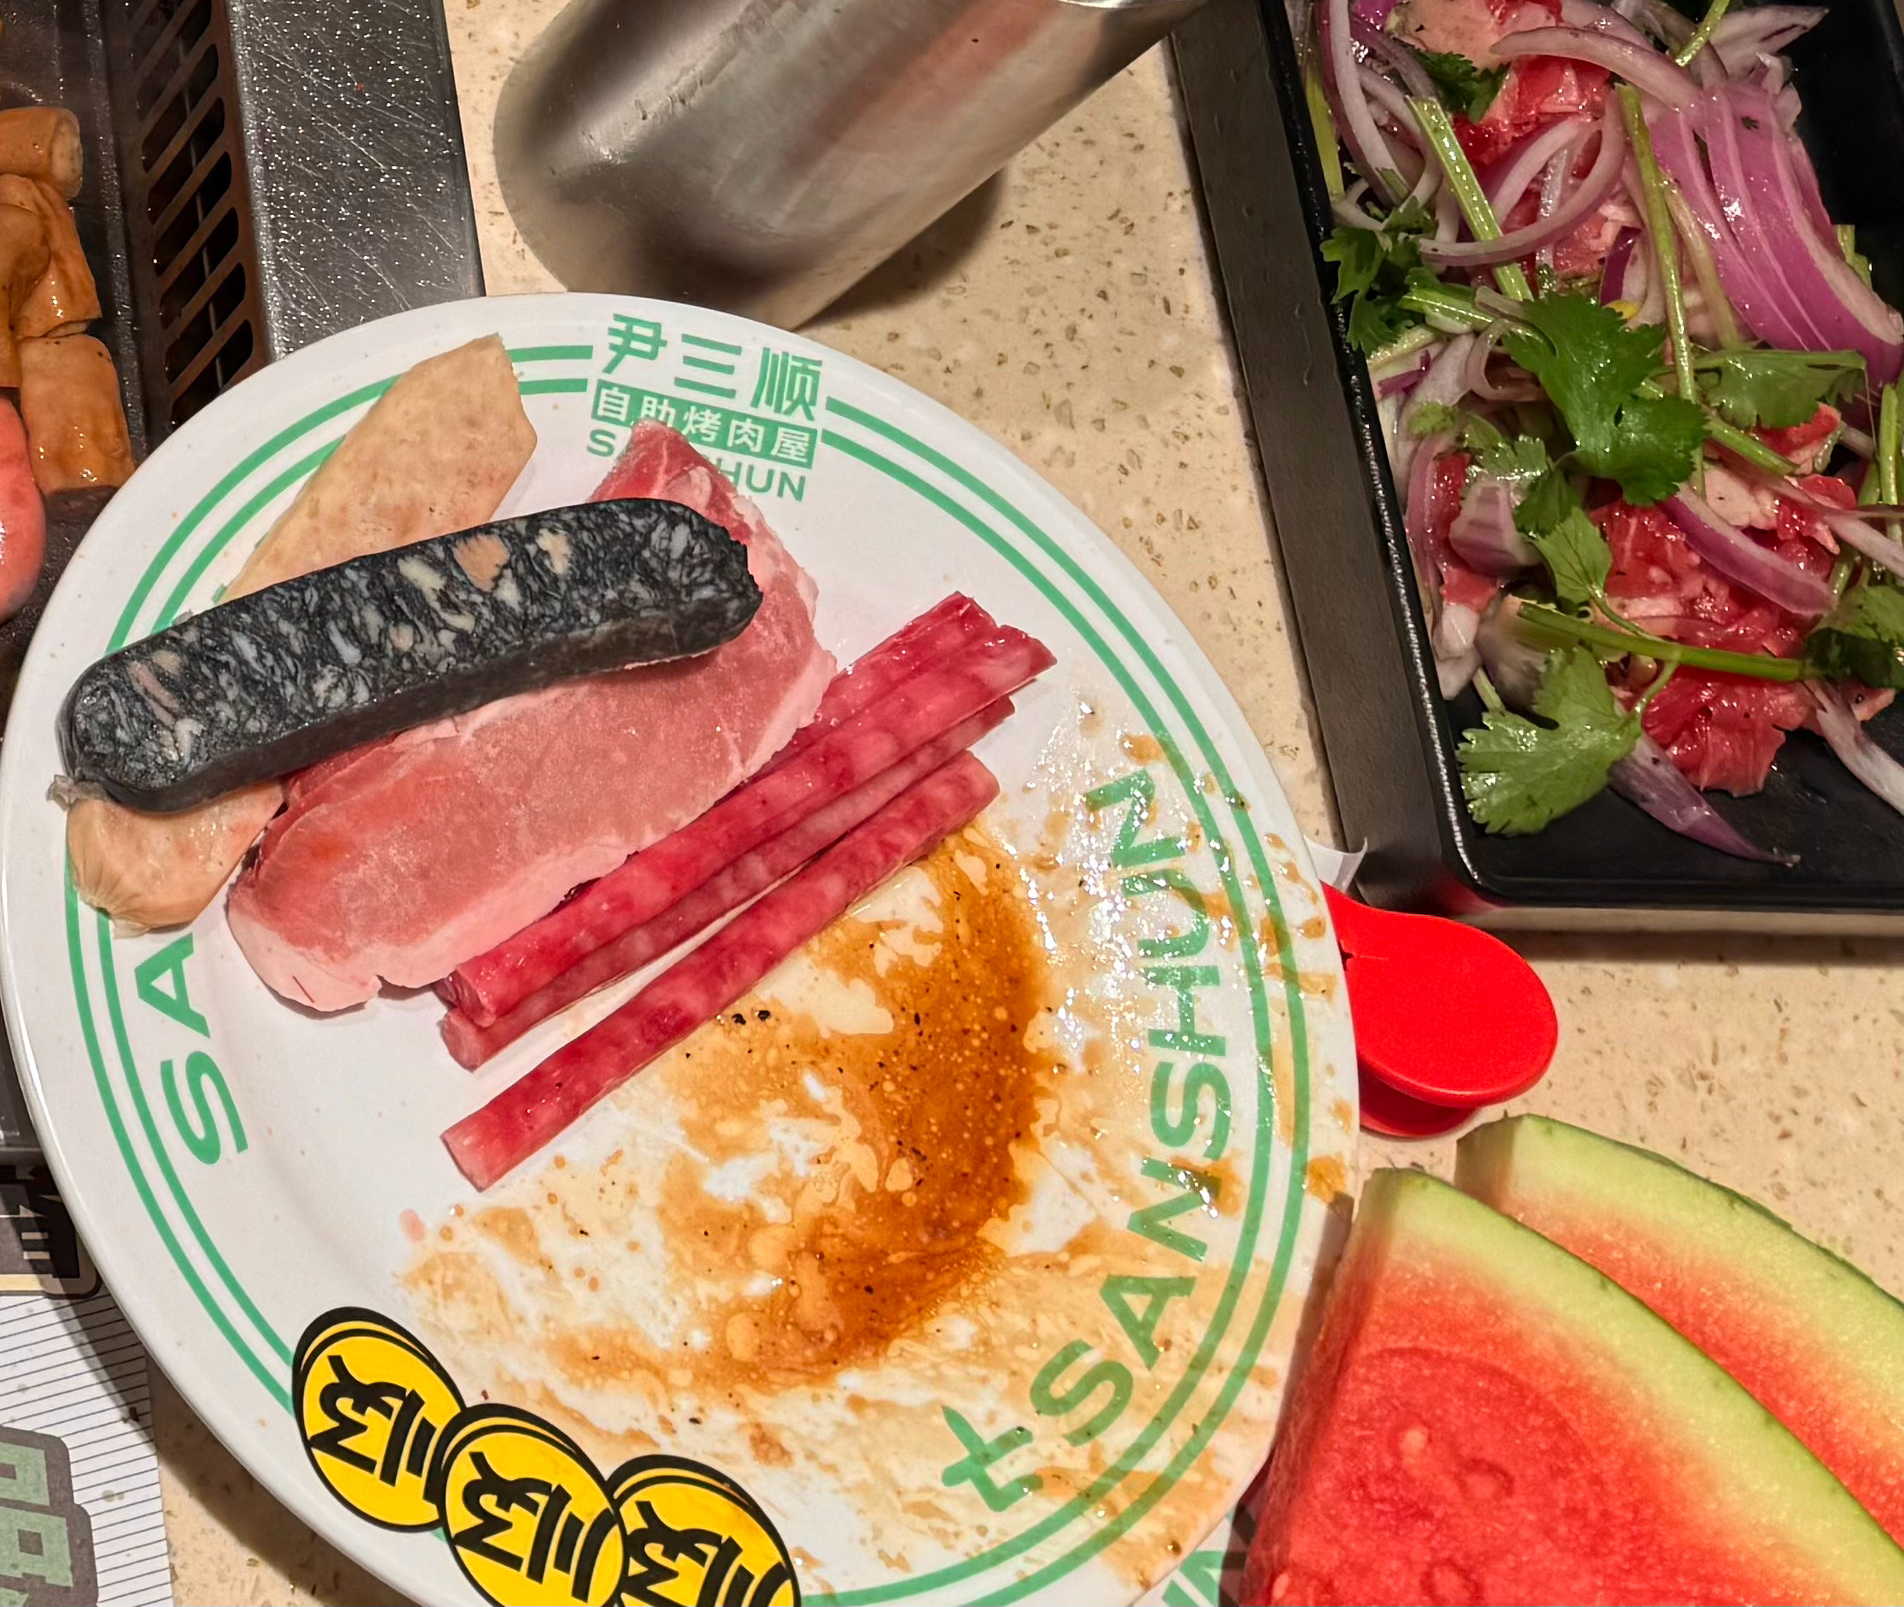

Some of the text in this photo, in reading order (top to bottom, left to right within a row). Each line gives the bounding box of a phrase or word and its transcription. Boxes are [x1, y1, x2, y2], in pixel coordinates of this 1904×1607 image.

[602, 313, 823, 421] 尹三顺
[586, 428, 807, 503] SHUN
[596, 386, 811, 465] 自助烤肉屋
[1029, 768, 1232, 1449] SANSHUN
